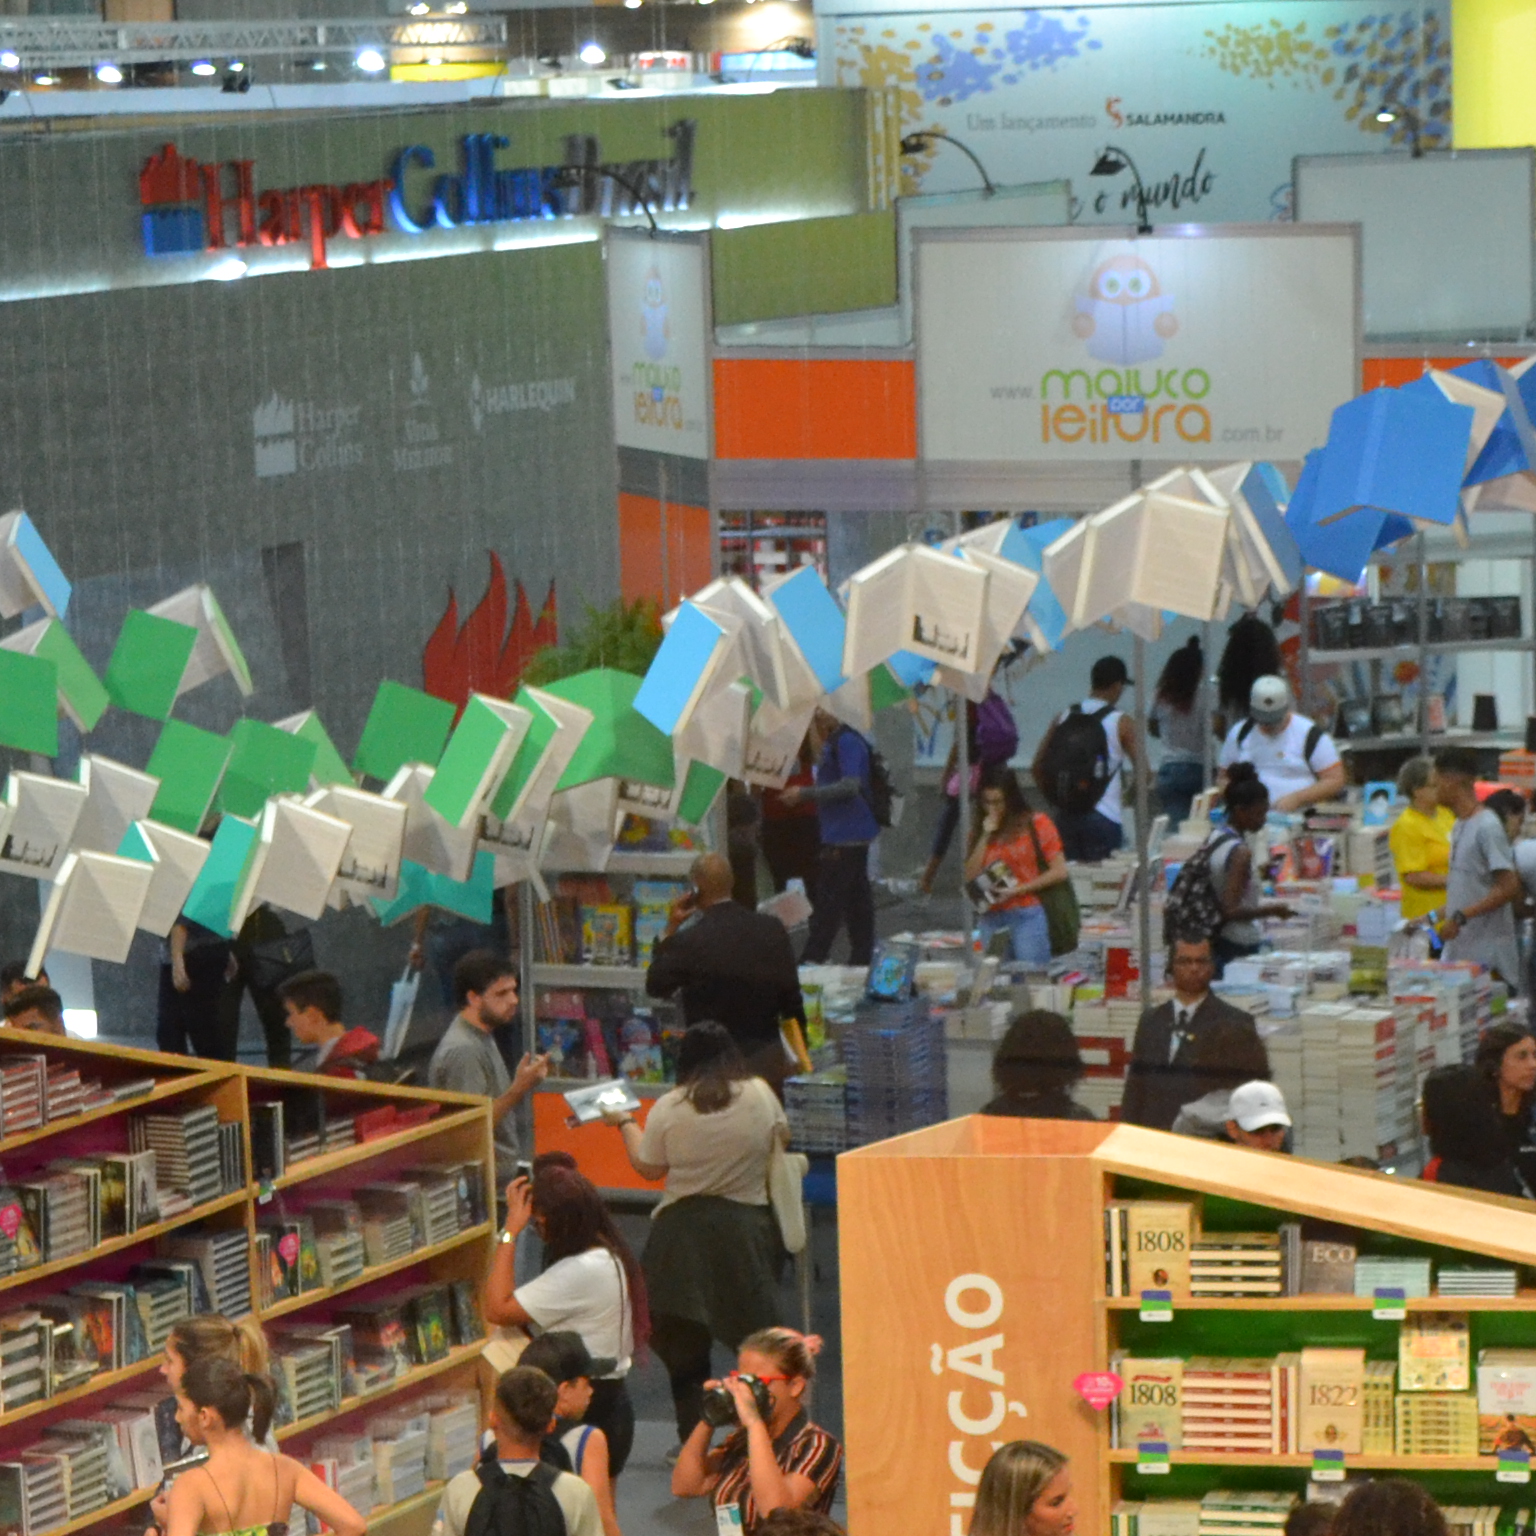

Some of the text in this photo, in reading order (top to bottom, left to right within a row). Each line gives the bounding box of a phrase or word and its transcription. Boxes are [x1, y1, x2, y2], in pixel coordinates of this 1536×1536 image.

[966, 111, 1226, 134] Um lançamento SALAMANDRA
[1040, 367, 1212, 399] maluco
[1041, 403, 1212, 443] leitura
[1136, 1230, 1186, 1252] 1808
[1312, 1247, 1355, 1263] ECO
[1130, 1384, 1177, 1406] 1808
[1309, 1383, 1357, 1407] 1822
